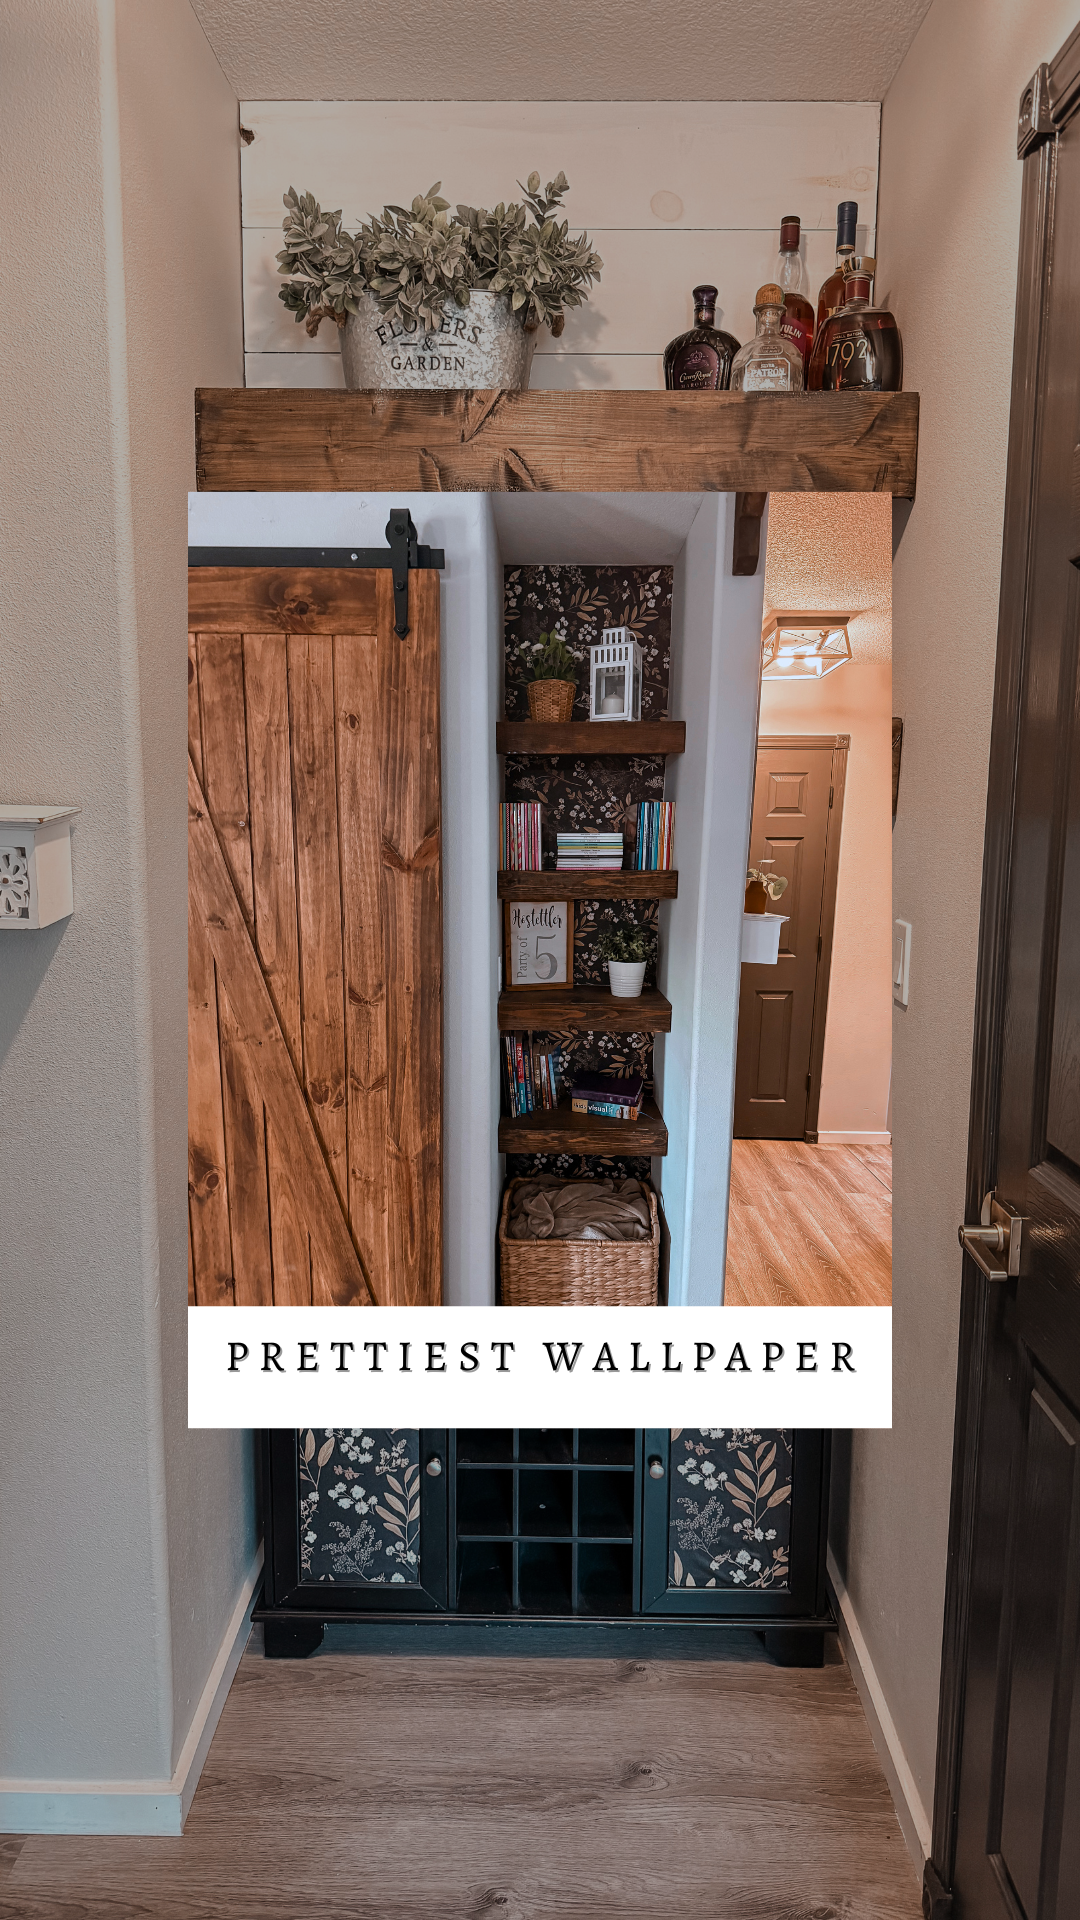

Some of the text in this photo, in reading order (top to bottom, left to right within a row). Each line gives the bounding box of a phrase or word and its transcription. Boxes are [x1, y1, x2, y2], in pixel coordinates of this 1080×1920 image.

[374, 316, 483, 347] FLOERS
[422, 336, 434, 352] &
[390, 355, 465, 371] GARDEN
[826, 339, 868, 369] 1792
[512, 905, 562, 928] Hostettler
[516, 935, 530, 978] Party of
[534, 934, 558, 980] 5
[588, 1104, 608, 1113] visual
